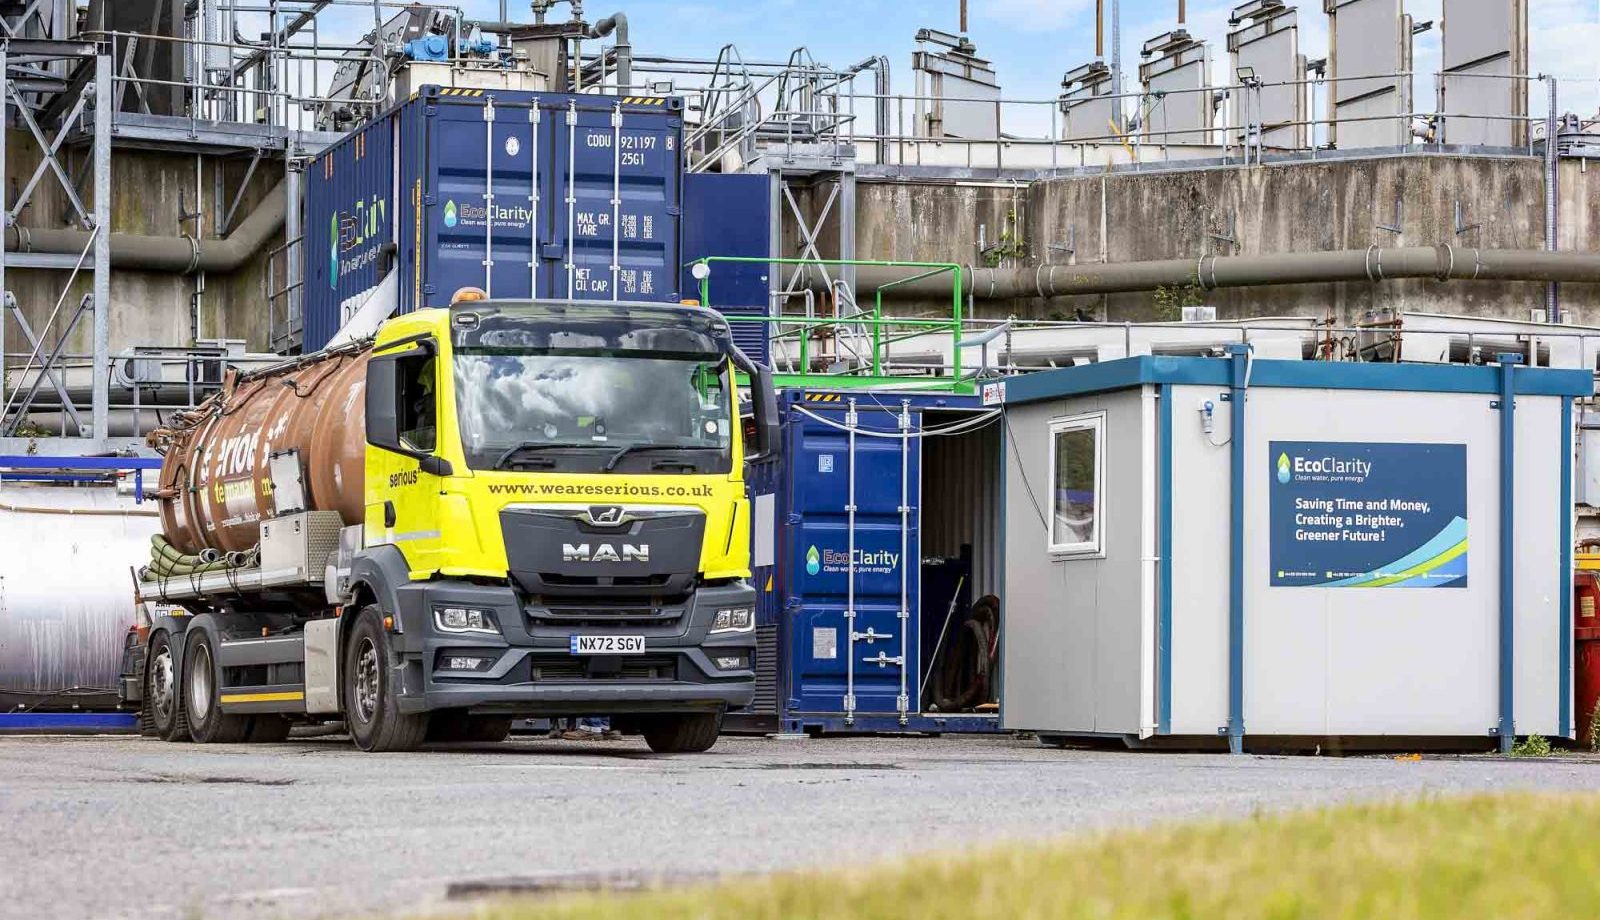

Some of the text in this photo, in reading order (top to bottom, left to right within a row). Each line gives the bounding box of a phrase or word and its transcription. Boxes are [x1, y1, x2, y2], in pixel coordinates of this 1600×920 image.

[621, 136, 656, 149] 921197
[621, 153, 644, 165] 25G1
[598, 213, 611, 225] GR.
[577, 224, 598, 236] TARE
[576, 268, 591, 280] NET
[591, 280, 609, 292] CAP.
[1294, 456, 1371, 477] EcoClarity
[390, 468, 418, 488] serious
[1344, 476, 1364, 484] energy
[488, 483, 713, 497] www.weareserious.co.uk
[1295, 498, 1430, 514] Saving Time and Money,
[1295, 513, 1404, 528] Creating a Brighter,
[1295, 529, 1385, 541] Greener Future!
[563, 543, 649, 562] MAN
[823, 549, 899, 569] EcoClarity
[580, 637, 642, 651] NX72 SGV
